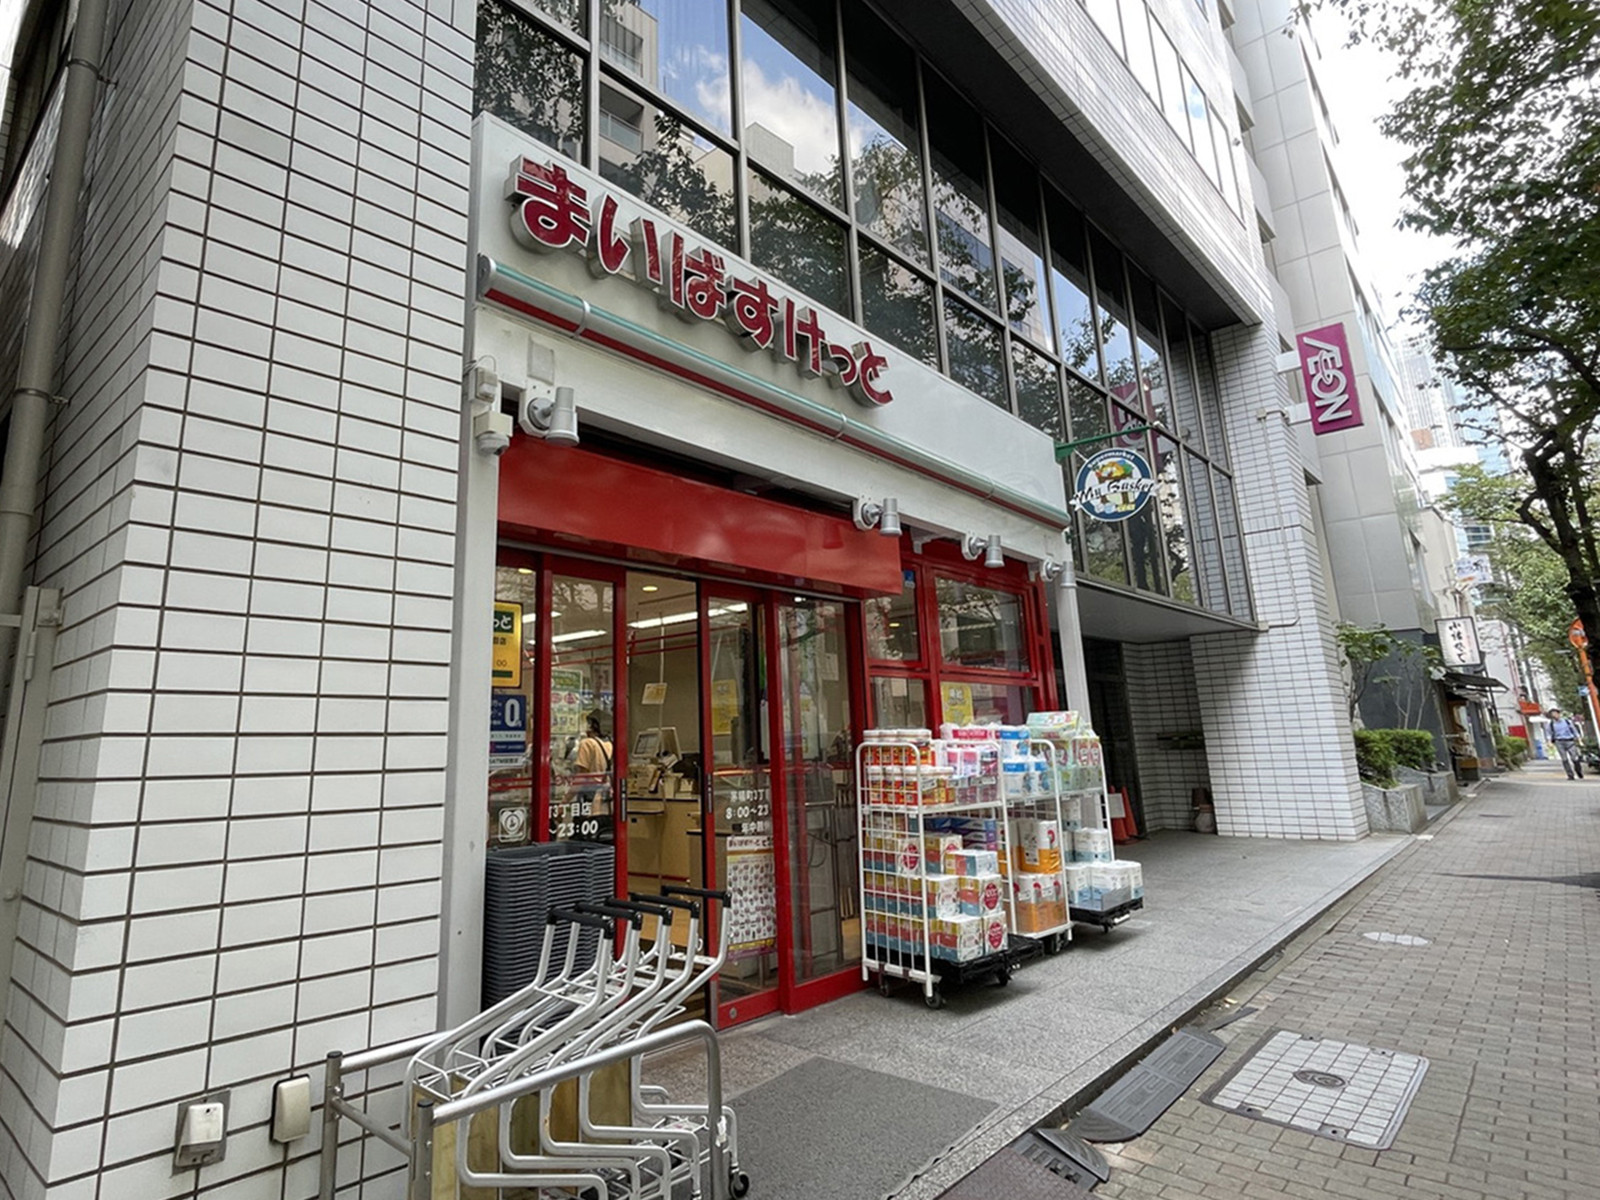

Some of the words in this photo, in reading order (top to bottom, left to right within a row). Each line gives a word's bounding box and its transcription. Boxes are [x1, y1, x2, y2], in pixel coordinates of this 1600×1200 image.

[508, 153, 894, 407] まいばすけっと
[1302, 336, 1353, 424] AEON
